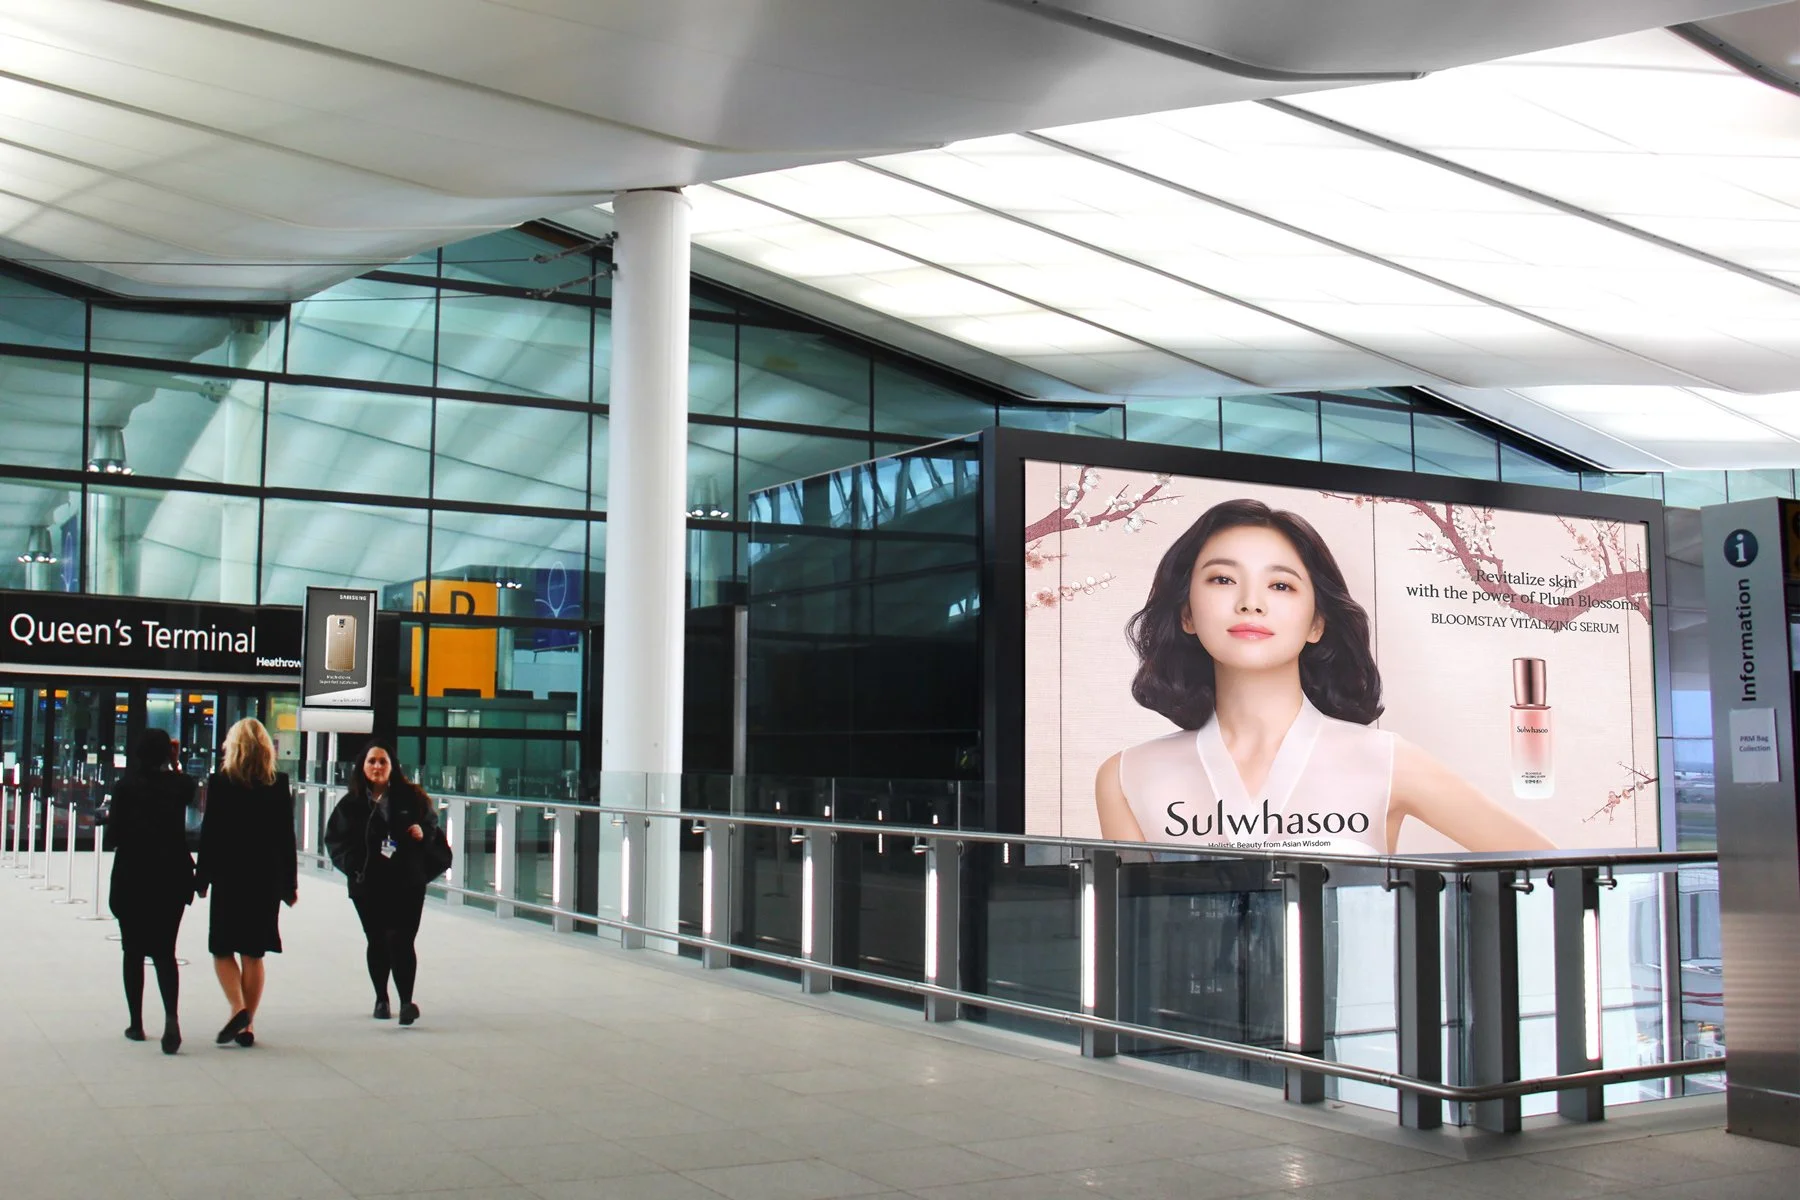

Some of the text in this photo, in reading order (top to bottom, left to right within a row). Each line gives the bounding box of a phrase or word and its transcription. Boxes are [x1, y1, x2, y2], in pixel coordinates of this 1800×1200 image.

[1476, 569, 1577, 588] Revitalize skin
[450, 590, 476, 615] D
[1406, 584, 1640, 611] with the power of Plum Blossoms
[10, 613, 256, 653] Queen's Terminal
[1431, 613, 1620, 634] BLOOMSTAY VITALIZING SERUM
[1736, 578, 1756, 701] Information
[256, 656, 301, 668] Heathrow
[1516, 726, 1549, 734] Sulwhasoo
[1165, 798, 1370, 837] Sulwhasoo
[1236, 841, 1262, 850] Beauty
[1263, 839, 1280, 848] from
[1282, 839, 1302, 848] Asian
[1302, 838, 1331, 848] Wisdom
